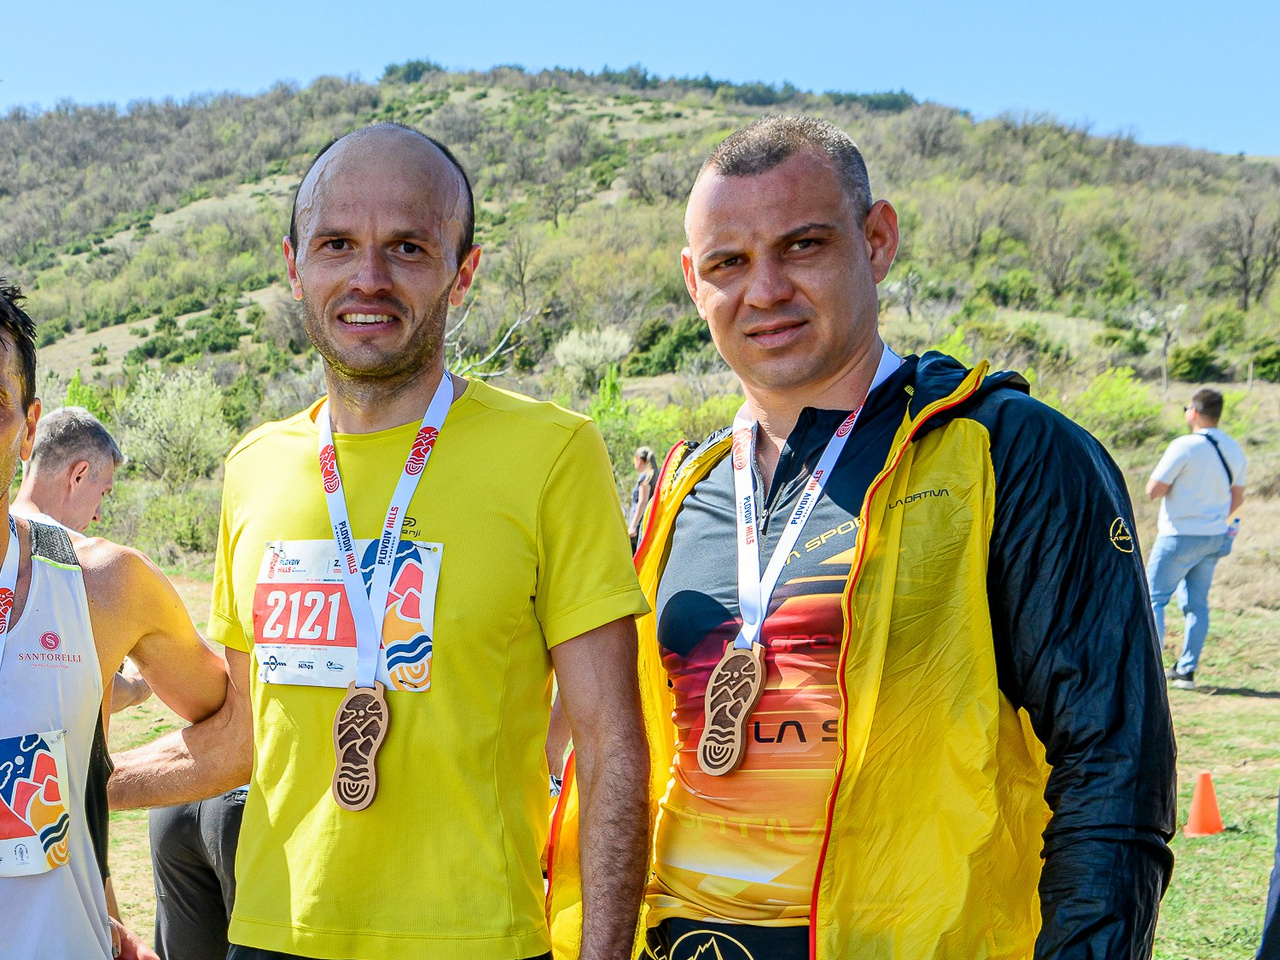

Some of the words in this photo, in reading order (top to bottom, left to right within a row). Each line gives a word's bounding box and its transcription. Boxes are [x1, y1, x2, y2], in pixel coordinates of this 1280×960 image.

[744, 496, 753, 525] PLOVDIV
[790, 492, 812, 525] PLOVDIV
[808, 470, 824, 491] HILLS
[339, 520, 353, 552] PLOVDIV
[346, 552, 358, 574] HILLS
[378, 530, 392, 565] PLOVDIV
[386, 506, 399, 529] HILLS
[746, 525, 754, 545] HILLS
[262, 590, 342, 641] 2121
[18, 652, 81, 662] SANTORELLI
[754, 721, 806, 743] LA
